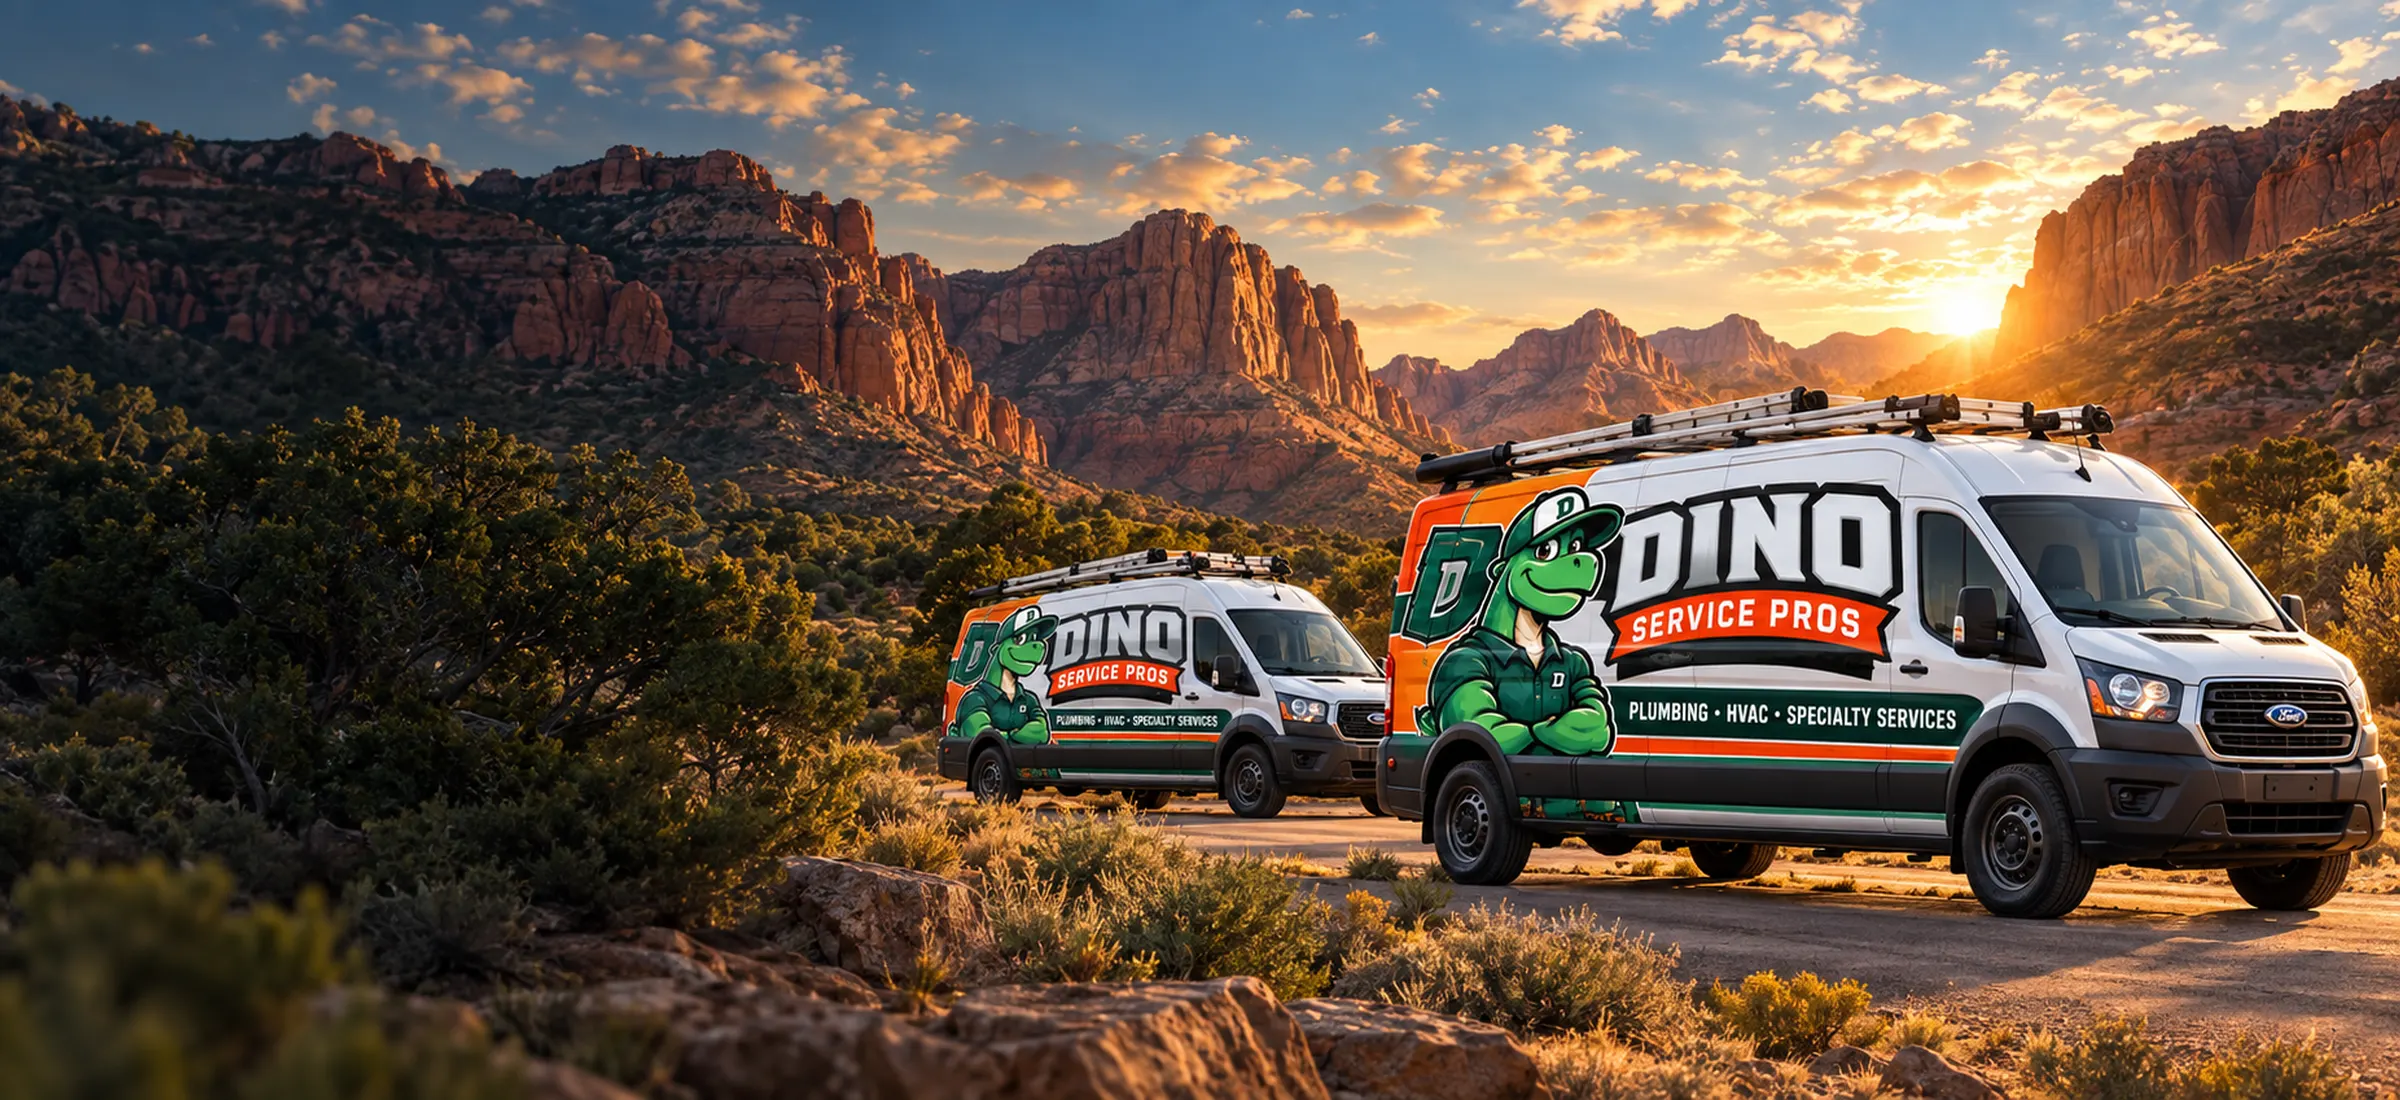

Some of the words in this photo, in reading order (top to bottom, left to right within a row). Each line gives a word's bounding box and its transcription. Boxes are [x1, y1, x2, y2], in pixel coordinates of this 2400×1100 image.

[1556, 496, 1575, 520] D
[1610, 491, 1894, 612] DINO
[1632, 598, 1755, 643] SERVICE
[1769, 598, 1860, 638] PROS
[1050, 609, 1183, 671] DINO
[1057, 664, 1119, 689] SERVICE
[1126, 664, 1168, 684] PROS
[1552, 672, 1565, 688] D
[1132, 715, 1175, 727] SPECIALTY
[1177, 715, 1218, 728] SERVICES
[1629, 701, 1709, 722] PLUMBING
[1726, 704, 1769, 724] HVAC
[1786, 705, 1873, 727] SPECIALTY
[1876, 708, 1957, 729] SERVICES
